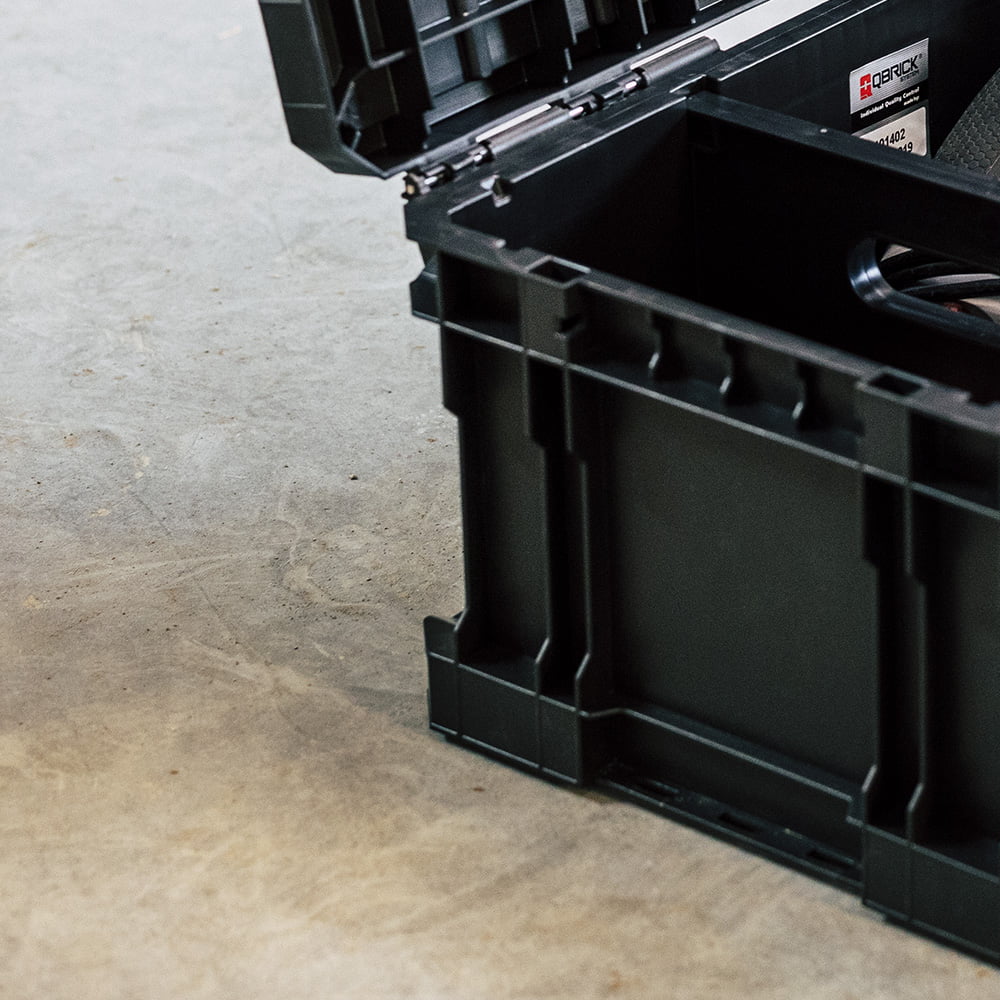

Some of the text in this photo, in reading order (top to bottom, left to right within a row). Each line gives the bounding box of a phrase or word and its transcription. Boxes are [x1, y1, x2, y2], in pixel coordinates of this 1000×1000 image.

[872, 55, 918, 88] QBRICK
[860, 86, 919, 118] Individual Quality Control
[876, 128, 905, 146] 01402
